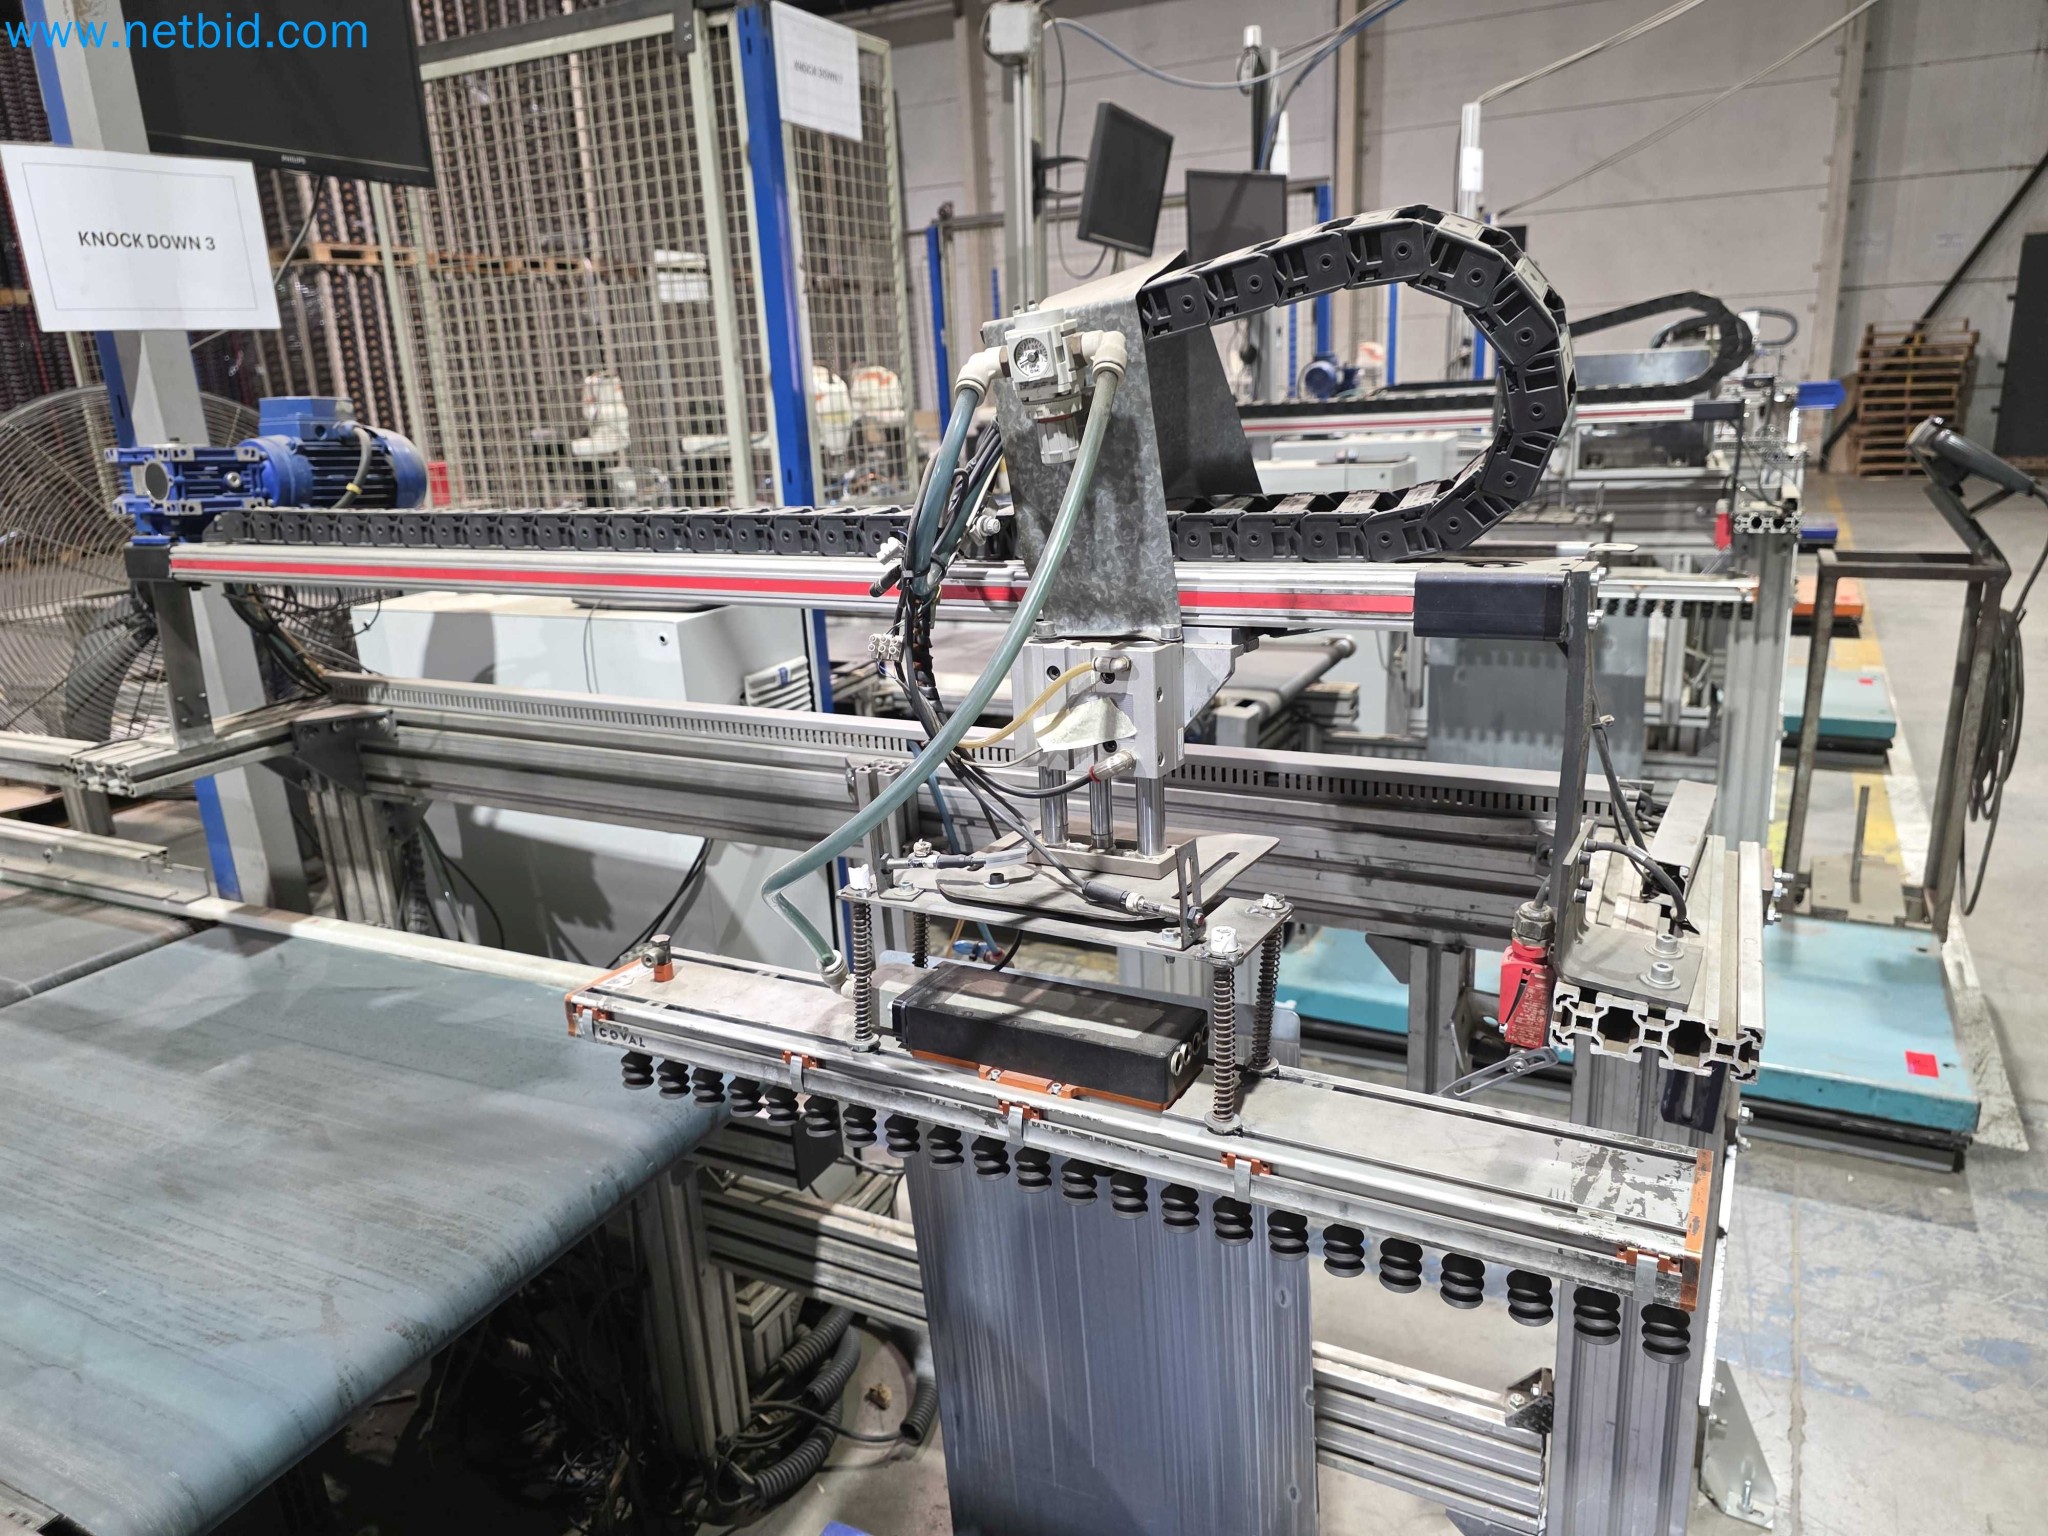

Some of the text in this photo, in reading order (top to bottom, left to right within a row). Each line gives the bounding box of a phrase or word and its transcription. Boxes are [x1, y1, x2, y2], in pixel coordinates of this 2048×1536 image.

[78, 230, 216, 251] KNOCK DOWN 3
[599, 1026, 646, 1048] COVAL
